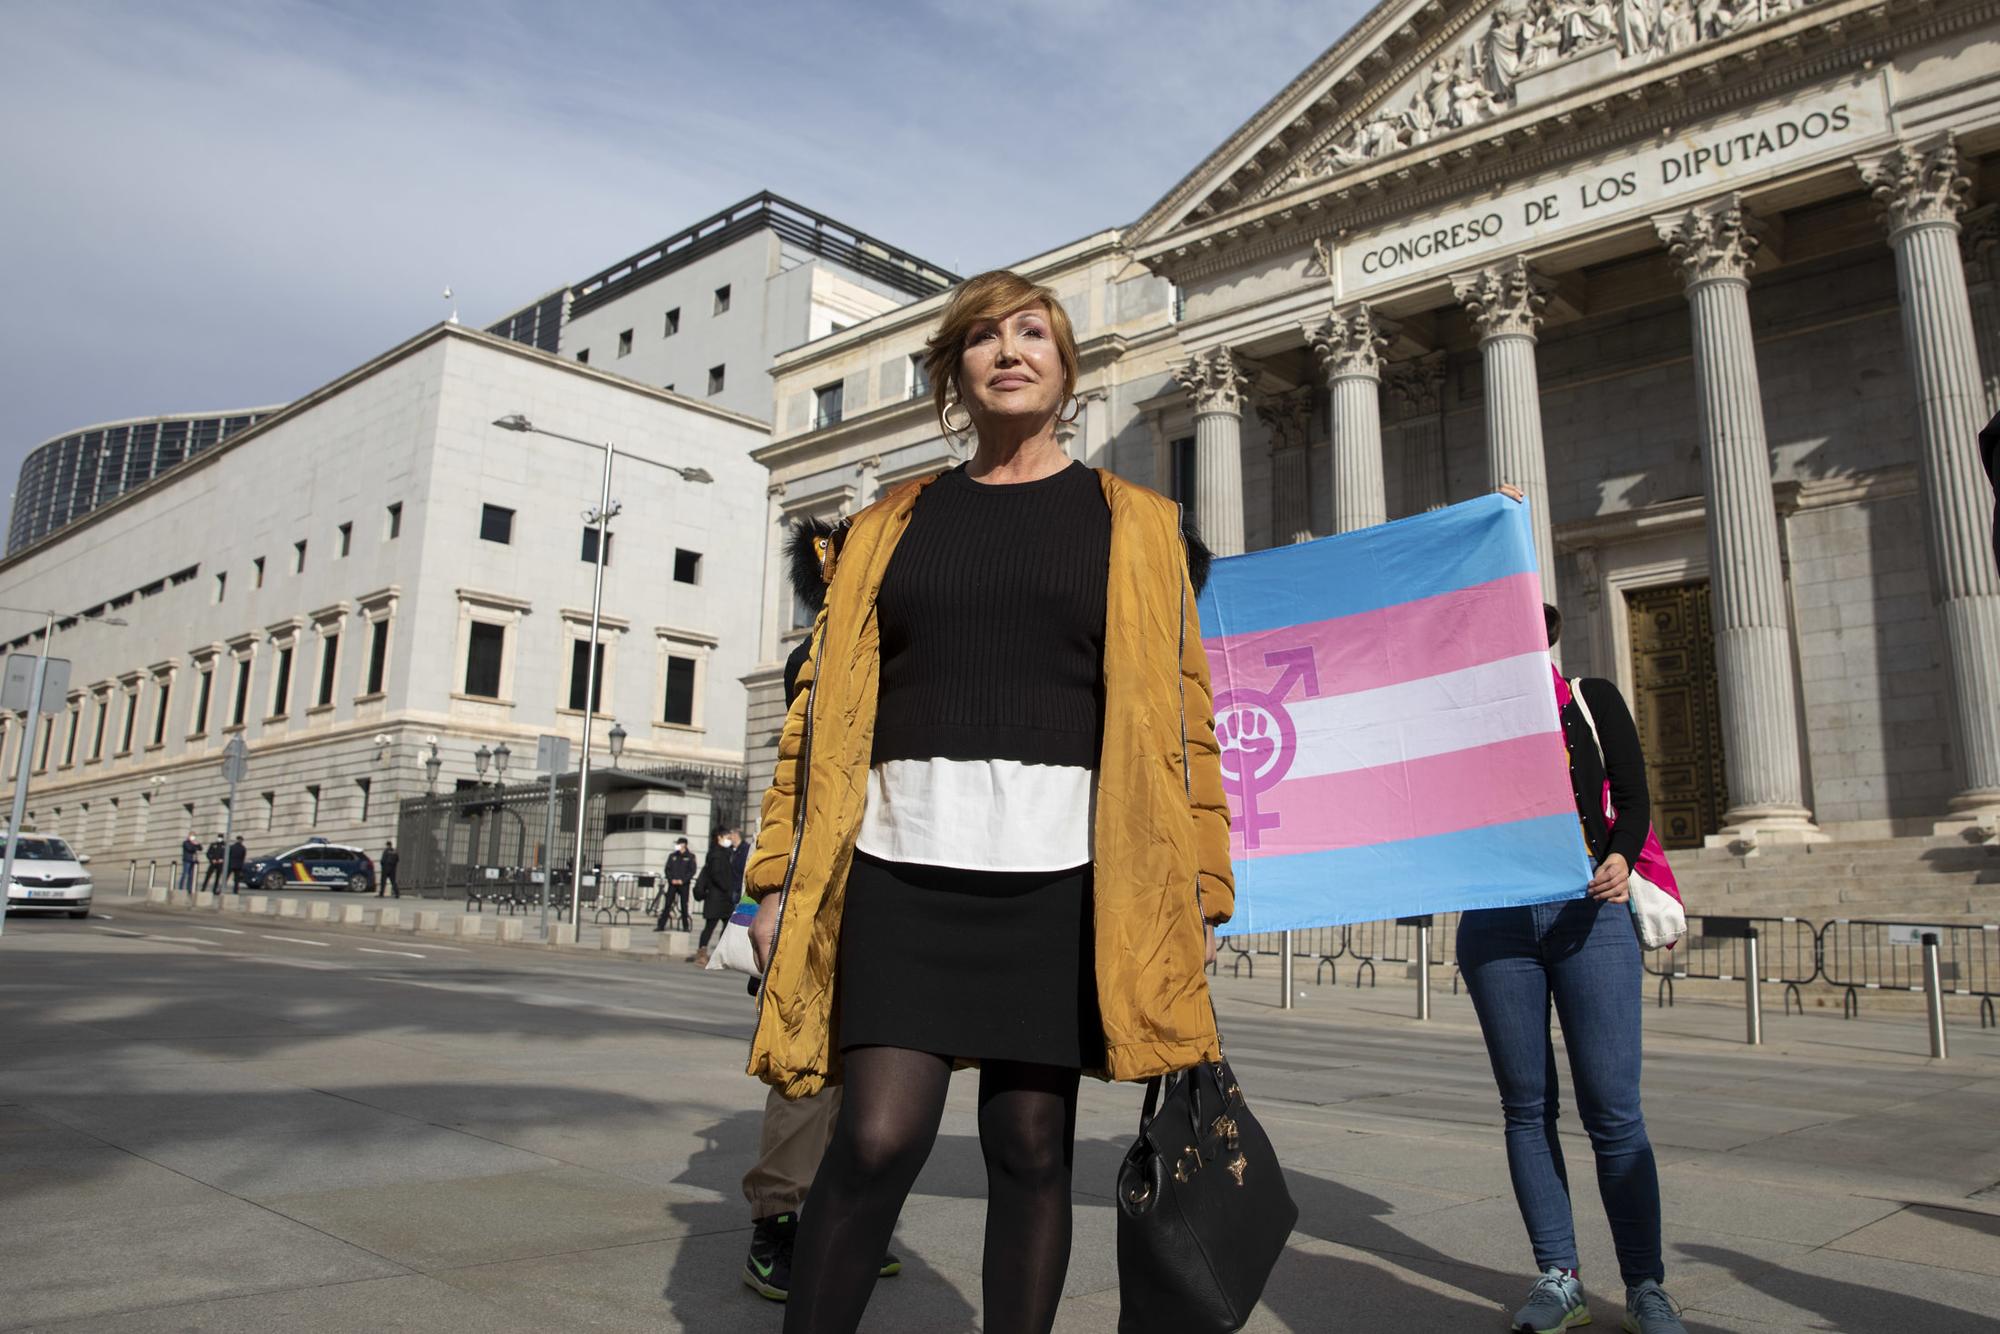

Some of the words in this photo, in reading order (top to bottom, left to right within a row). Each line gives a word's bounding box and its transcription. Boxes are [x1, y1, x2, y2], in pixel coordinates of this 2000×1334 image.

[1362, 213, 1503, 274] CONGRESO
[1524, 195, 1560, 226] DE
[1580, 172, 1637, 208] LOS
[1661, 104, 1850, 184] DIPUTADOS
